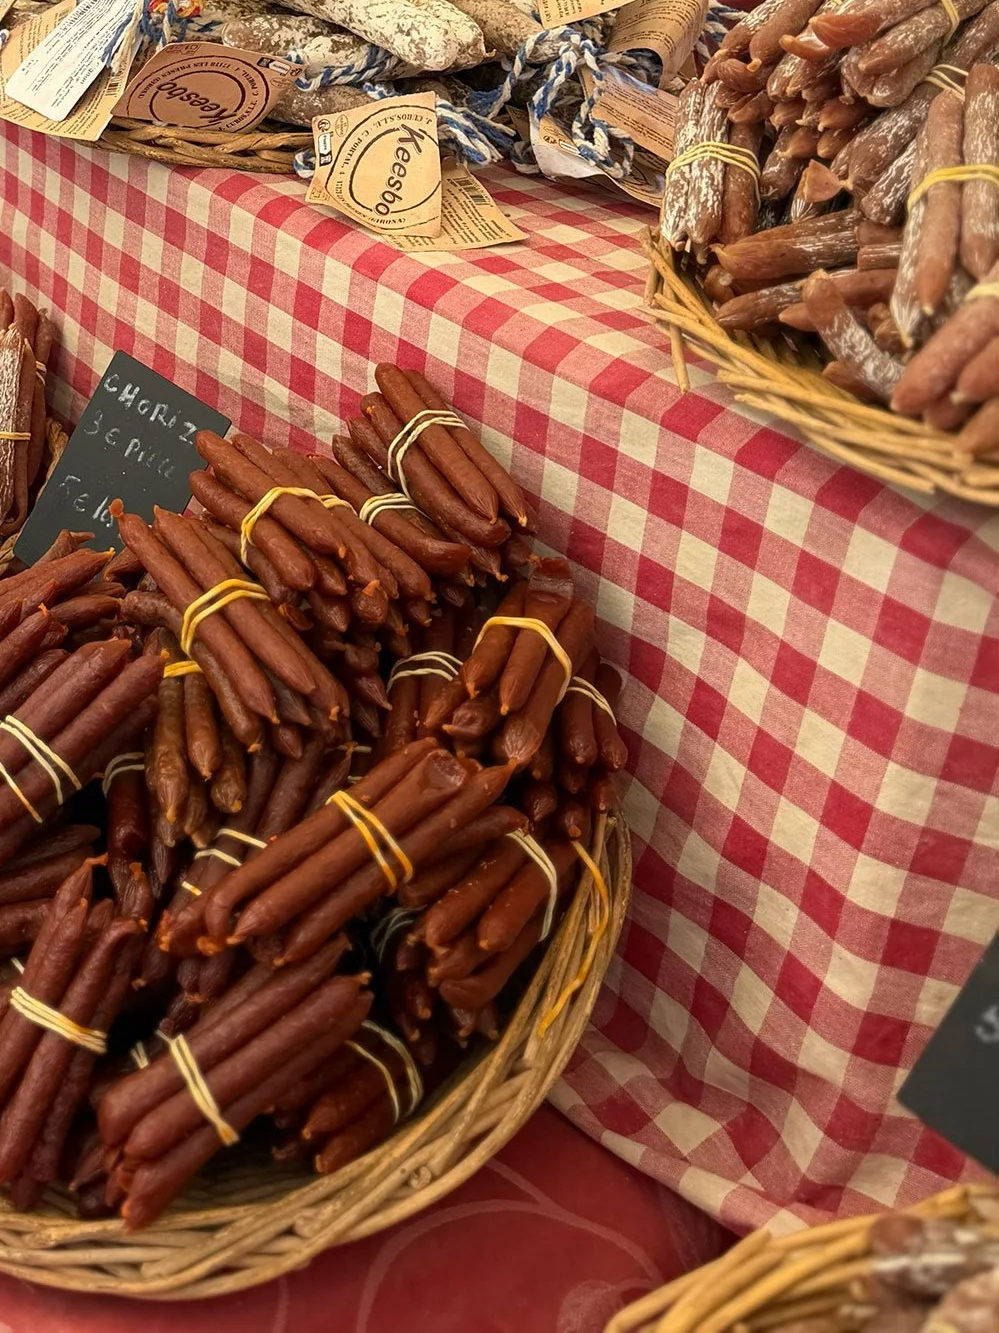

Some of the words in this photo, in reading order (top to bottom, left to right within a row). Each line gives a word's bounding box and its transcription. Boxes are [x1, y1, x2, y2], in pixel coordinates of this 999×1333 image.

[156, 80, 238, 124] Keesbo
[374, 123, 424, 216] Keesbo
[103, 374, 198, 445] CHORIZ
